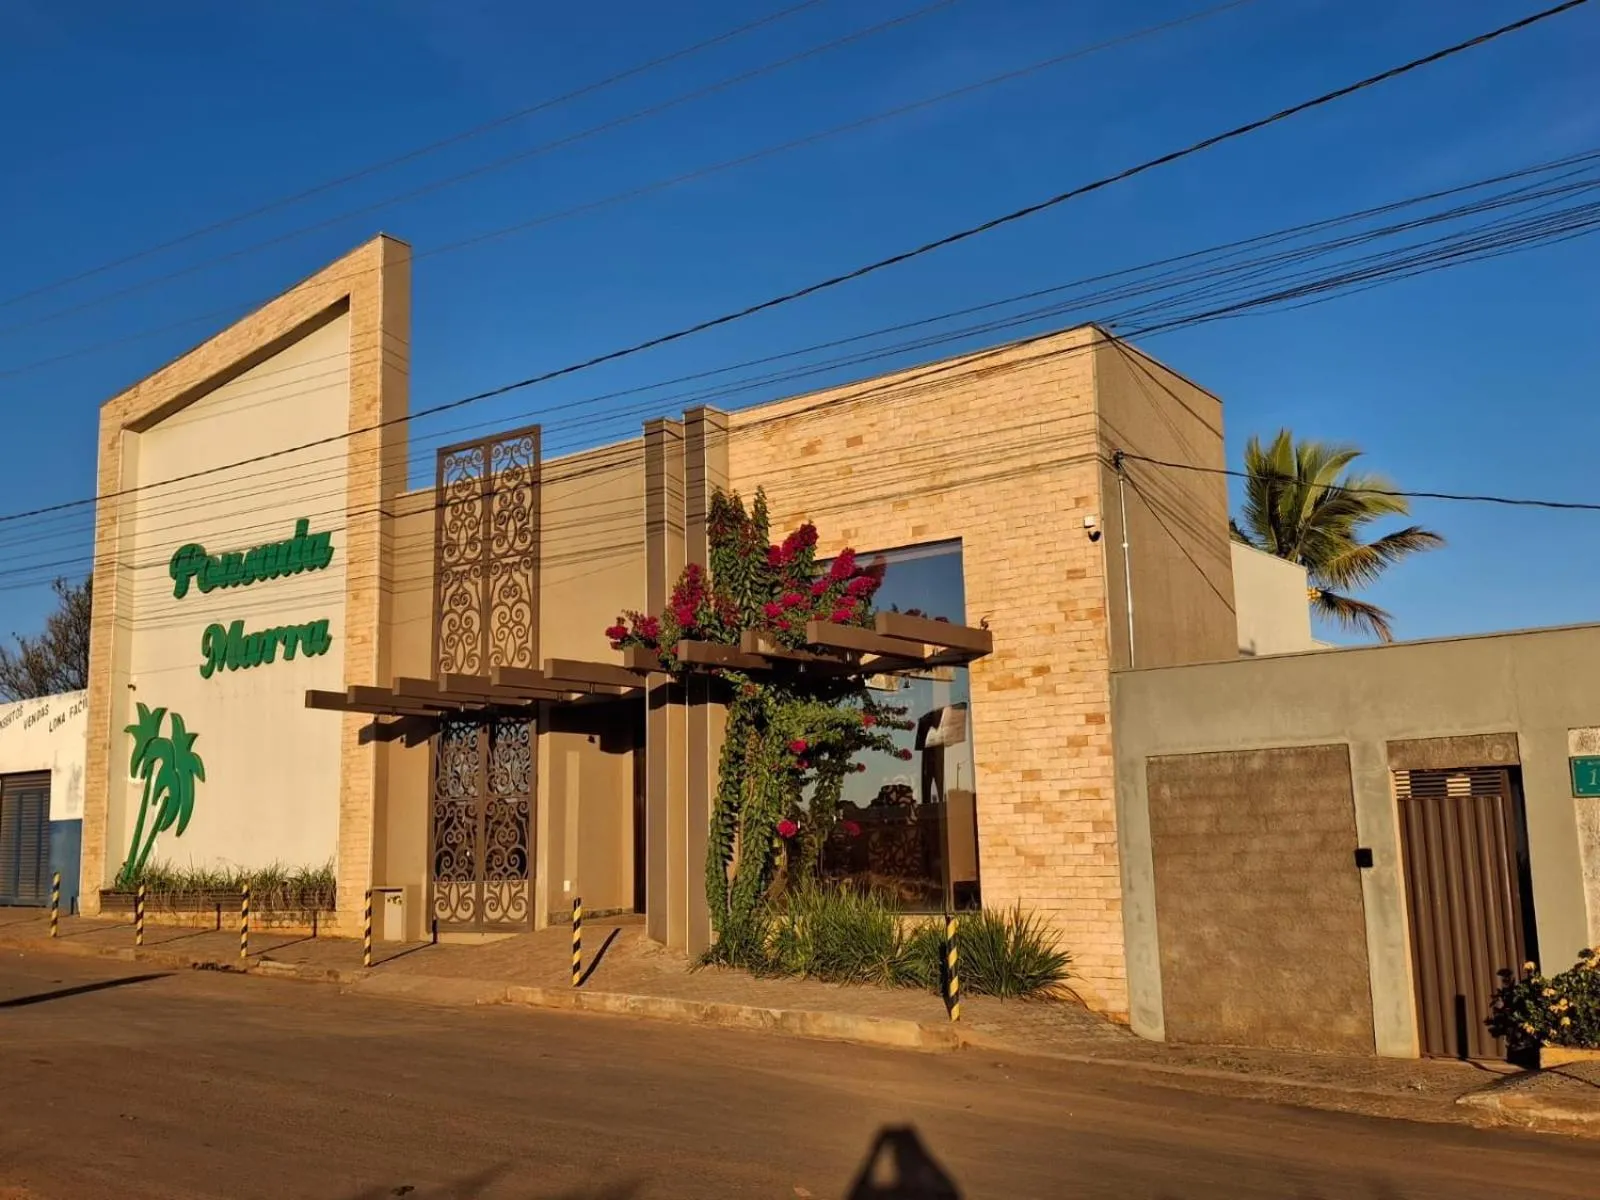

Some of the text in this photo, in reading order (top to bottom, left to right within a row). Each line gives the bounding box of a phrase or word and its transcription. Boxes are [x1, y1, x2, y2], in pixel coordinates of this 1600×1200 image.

[169, 518, 335, 599] Pousada
[200, 618, 333, 679] Marra
[23, 703, 49, 730] VENDAS
[1588, 768, 1600, 786] 1
